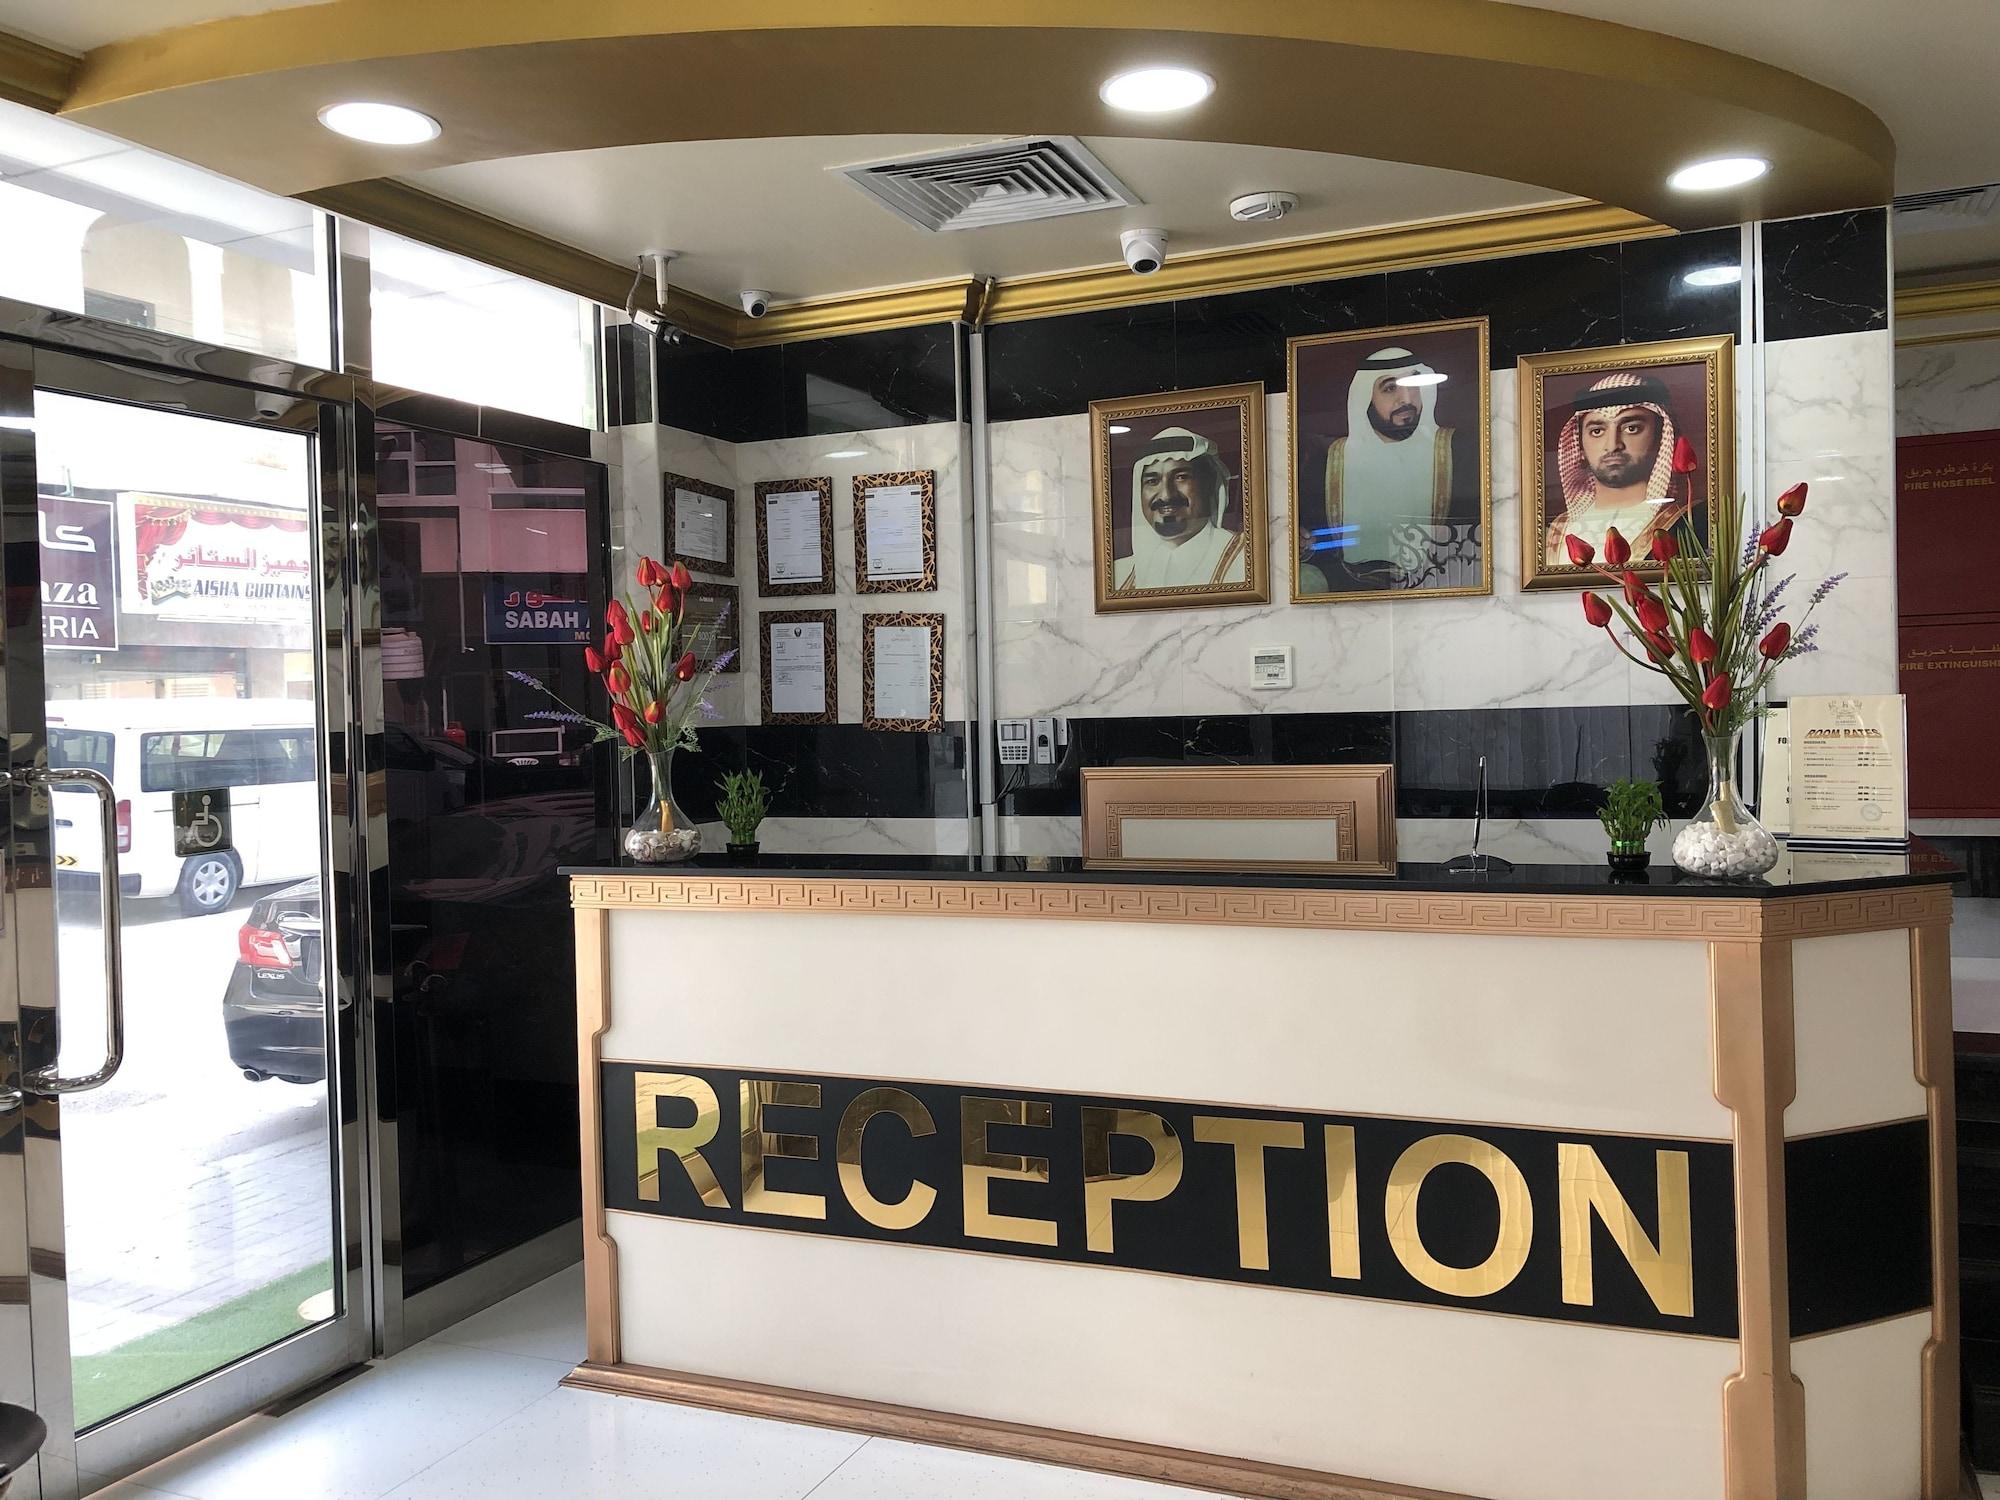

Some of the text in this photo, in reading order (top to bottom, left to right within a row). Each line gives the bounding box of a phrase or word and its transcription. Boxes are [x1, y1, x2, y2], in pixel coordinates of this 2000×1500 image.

[1904, 476, 1995, 491] FIRE HOSE REEL
[193, 578, 310, 601] AISHA CURTAINS
[505, 610, 579, 629] SABAH
[1900, 661, 1925, 671] FIRE
[1804, 728, 1883, 739] ROOM RATES
[257, 972, 286, 980] LEXUS
[633, 1070, 1694, 1318] RECEPTION
